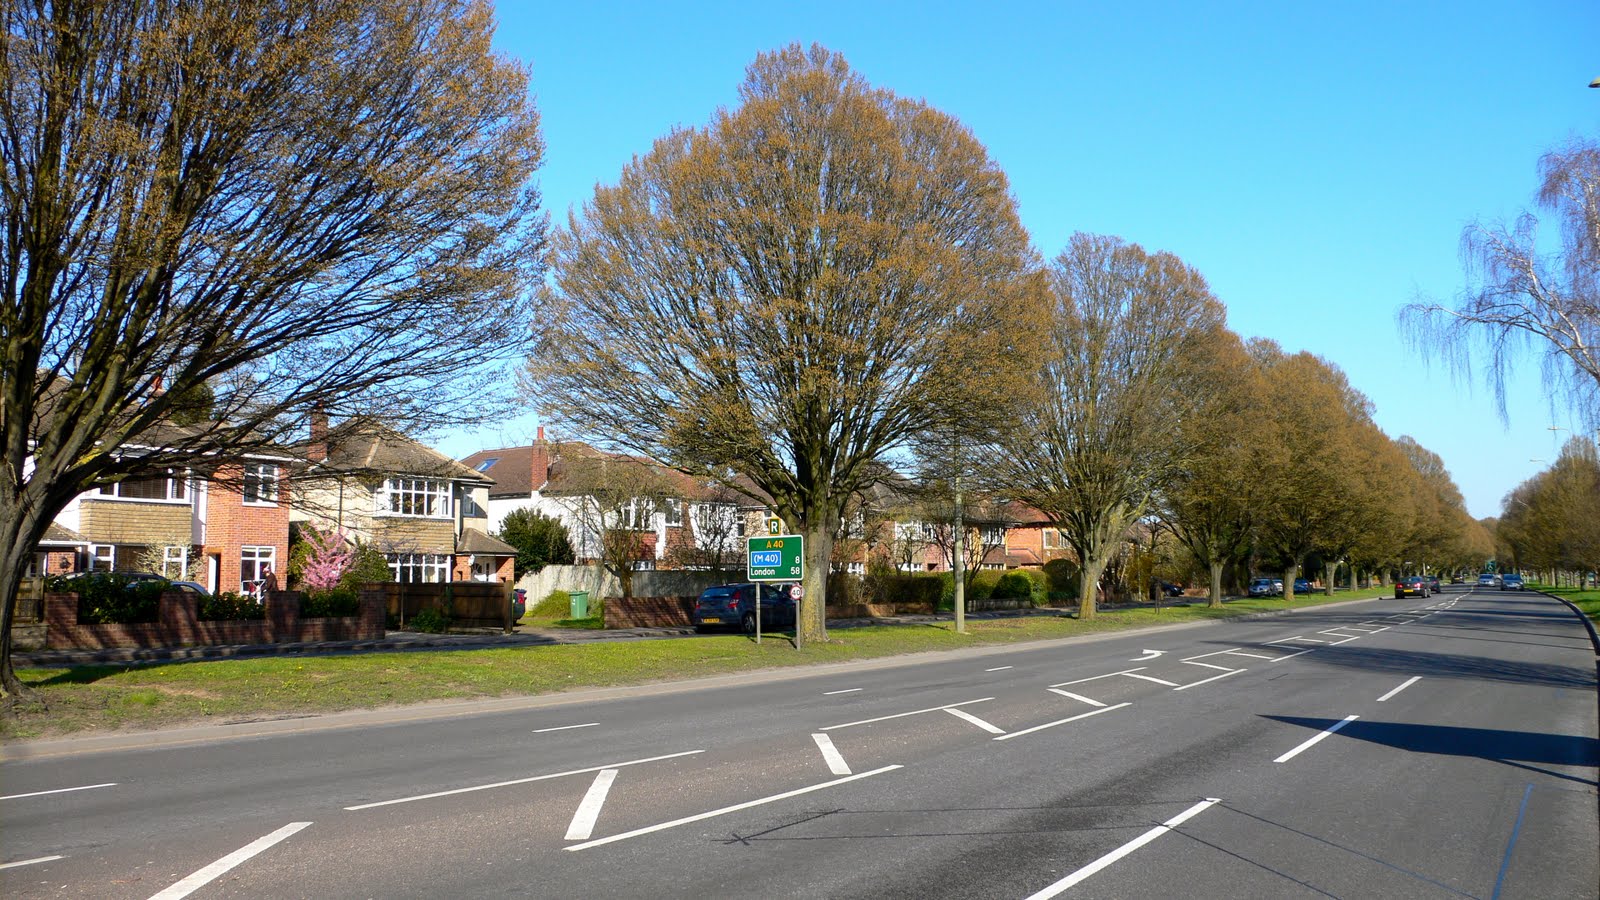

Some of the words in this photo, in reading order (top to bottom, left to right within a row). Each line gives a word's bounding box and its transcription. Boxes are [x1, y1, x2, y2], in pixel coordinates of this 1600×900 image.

[771, 521, 778, 533] R
[795, 556, 800, 564] 8
[750, 568, 776, 576] London
[790, 567, 800, 575] 58
